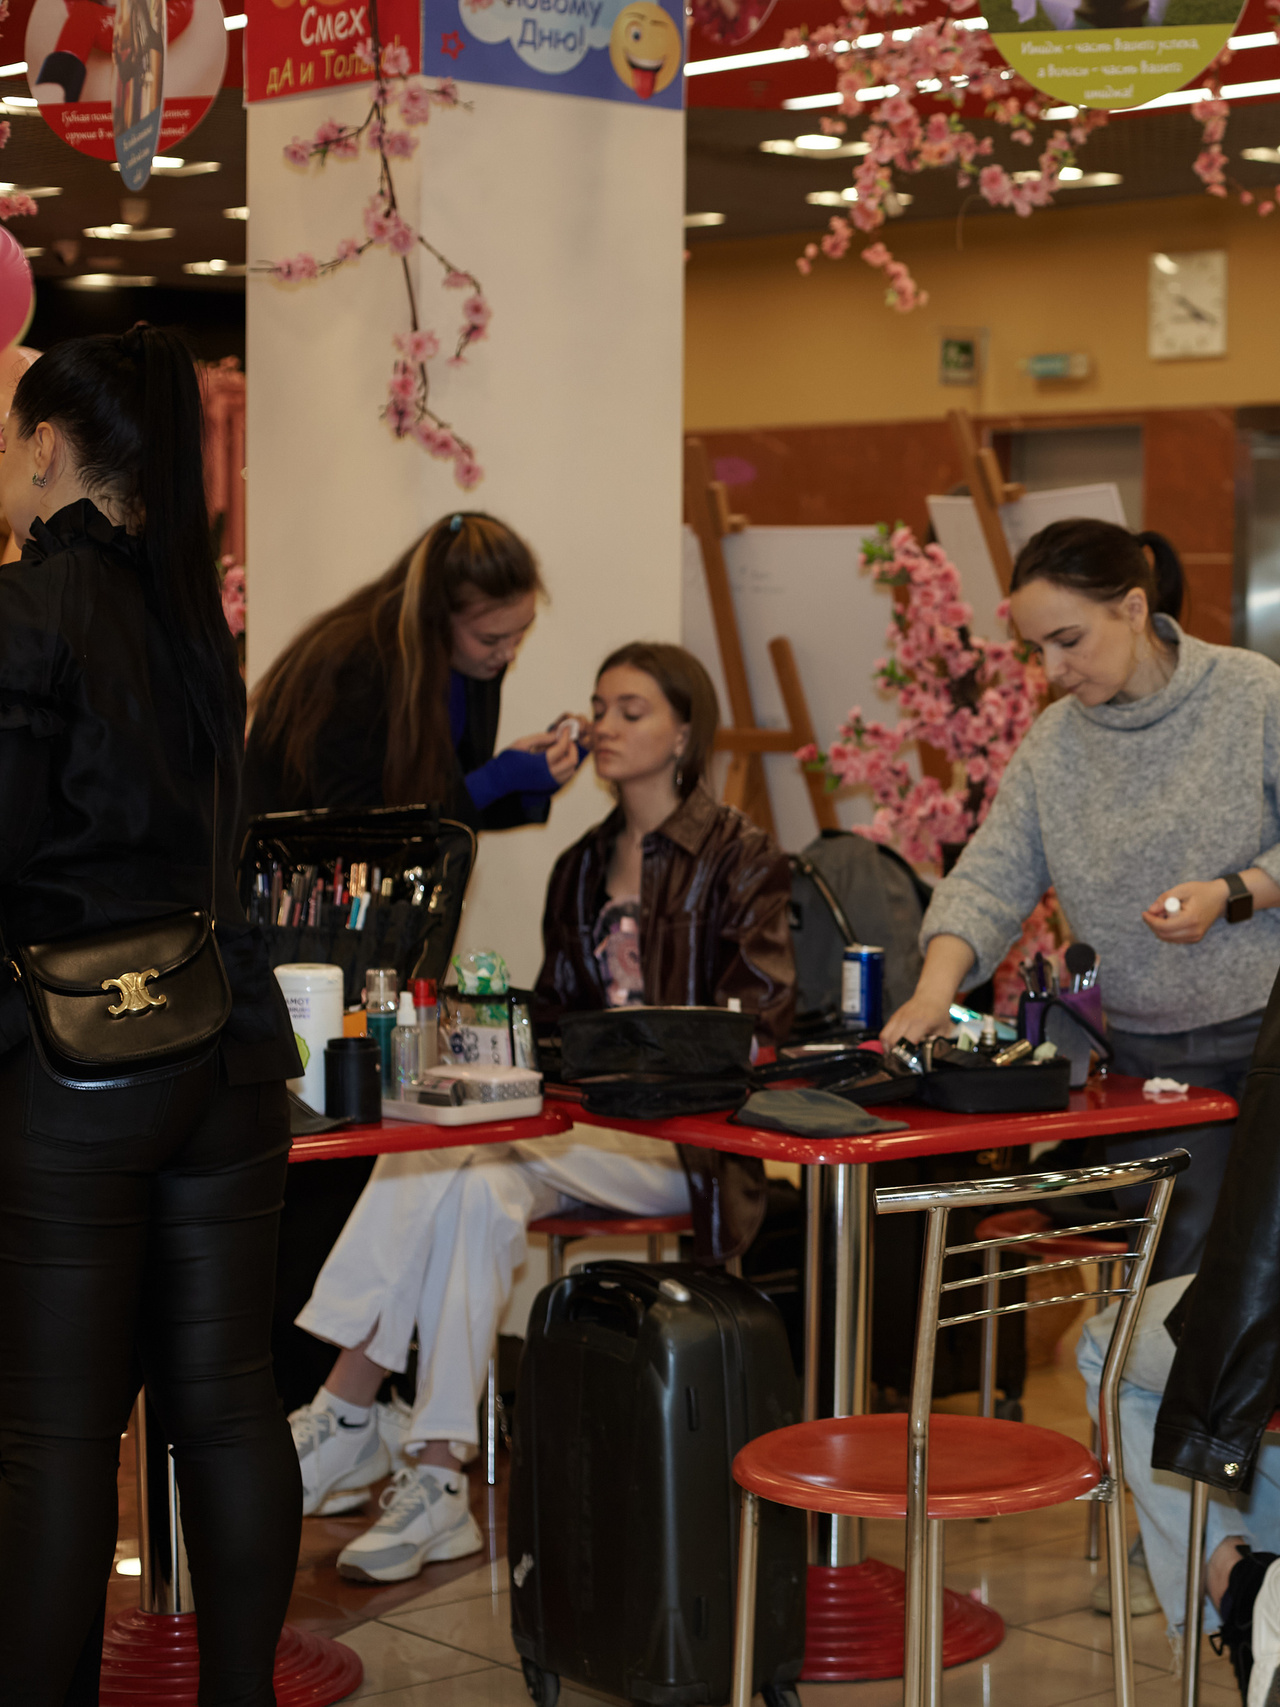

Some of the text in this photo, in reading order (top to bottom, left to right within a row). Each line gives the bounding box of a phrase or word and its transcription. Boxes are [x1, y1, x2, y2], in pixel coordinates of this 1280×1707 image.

[300, 5, 367, 46] Смех
[509, 0, 601, 26] овому
[517, 18, 586, 52] Дню!
[1020, 41, 1063, 55] Имидж
[1075, 42, 1113, 53] часть
[300, 61, 315, 86] и
[1037, 67, 1046, 78] а
[1101, 64, 1138, 76] часть
[61, 110, 113, 128] Губная пома
